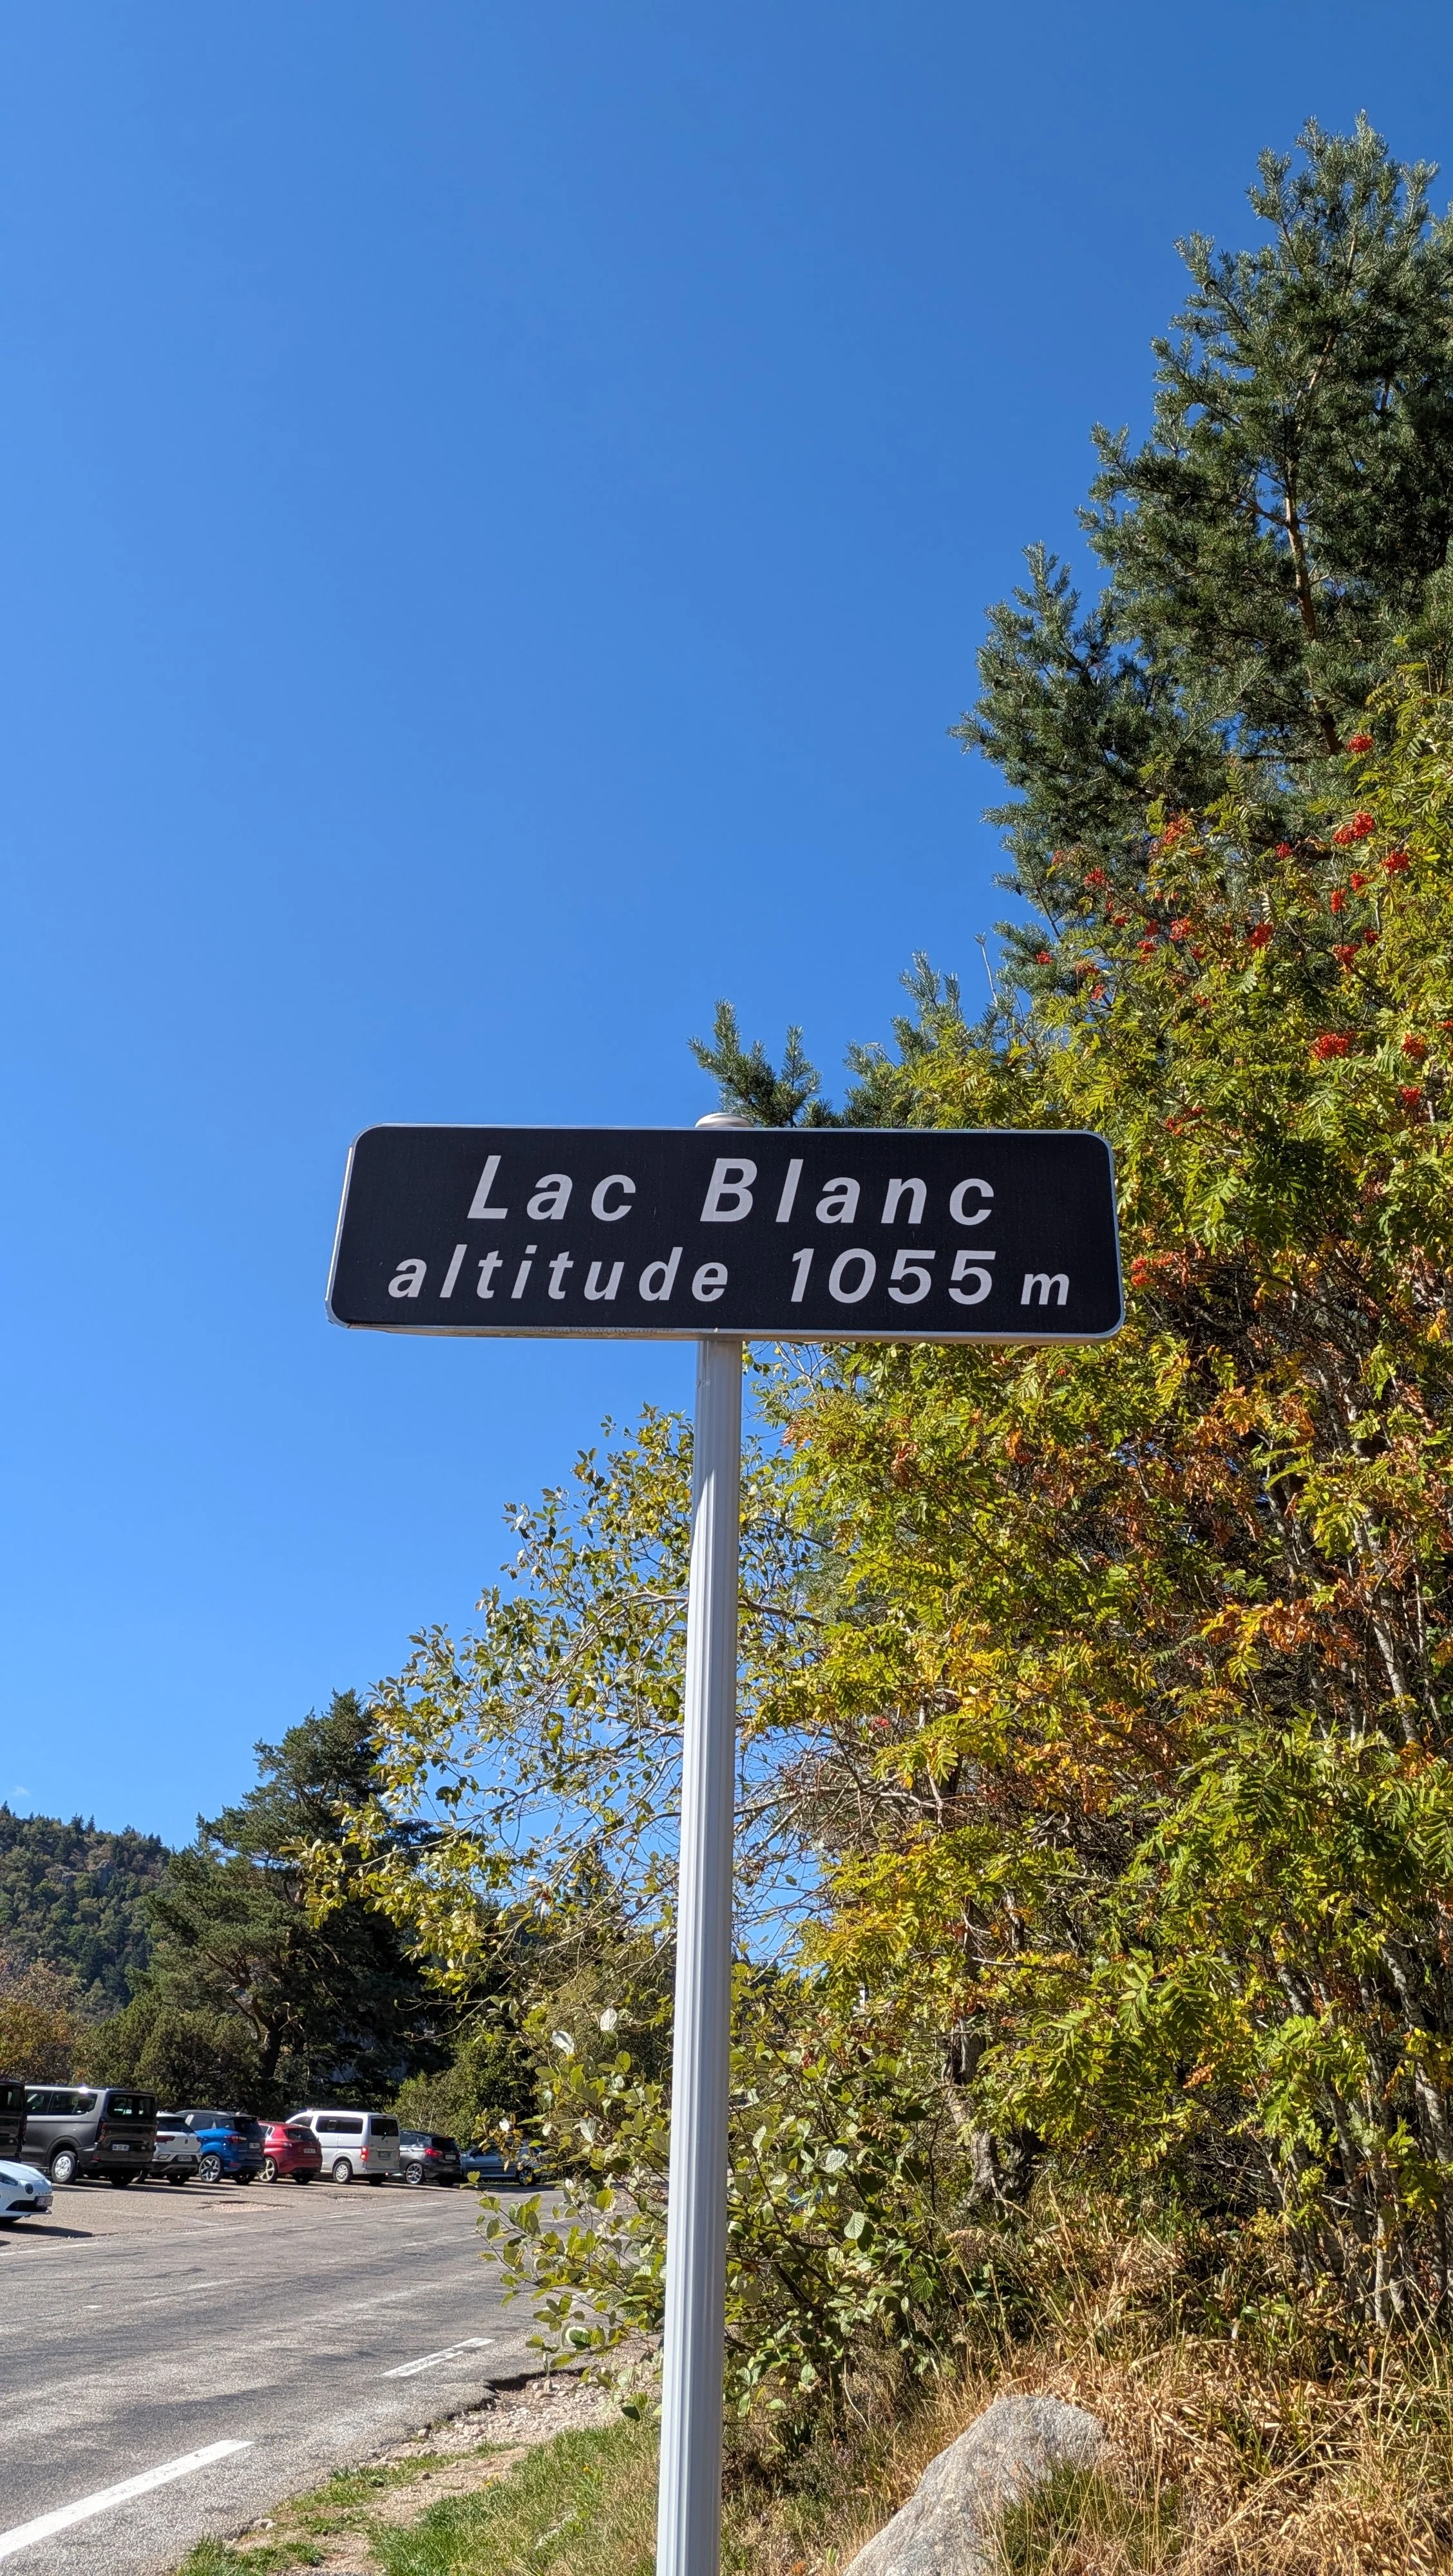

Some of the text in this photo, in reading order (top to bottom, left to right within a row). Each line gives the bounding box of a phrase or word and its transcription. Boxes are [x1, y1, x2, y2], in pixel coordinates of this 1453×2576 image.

[468, 1155, 994, 1226] Lac Blanc
[388, 1244, 1070, 1305] altitude 1055 m
